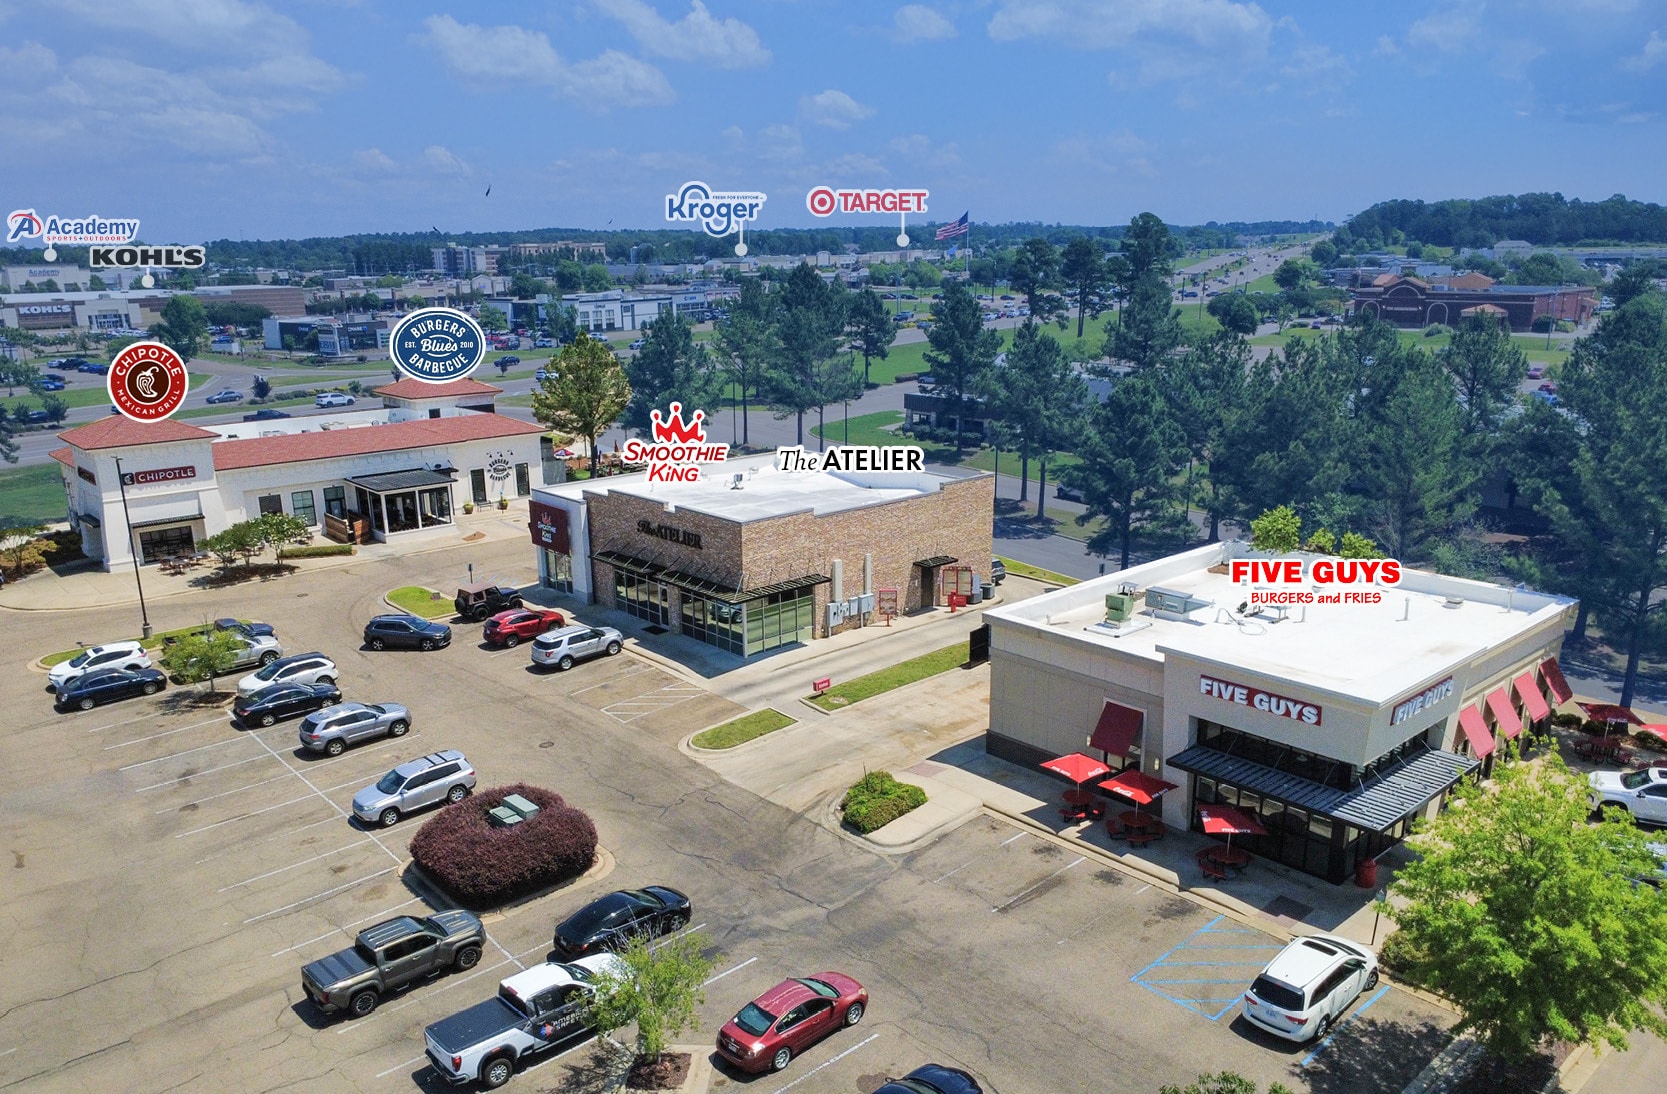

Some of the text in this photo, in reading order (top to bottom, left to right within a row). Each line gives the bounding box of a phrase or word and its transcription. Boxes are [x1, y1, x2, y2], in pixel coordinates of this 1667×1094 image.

[19, 305, 71, 314] KOHL'S
[138, 468, 194, 482] CHIPOTLE
[656, 524, 703, 550] ATELIER
[1200, 678, 1319, 724] FIVE GUYS
[1394, 679, 1454, 726] FIVE GUYS
